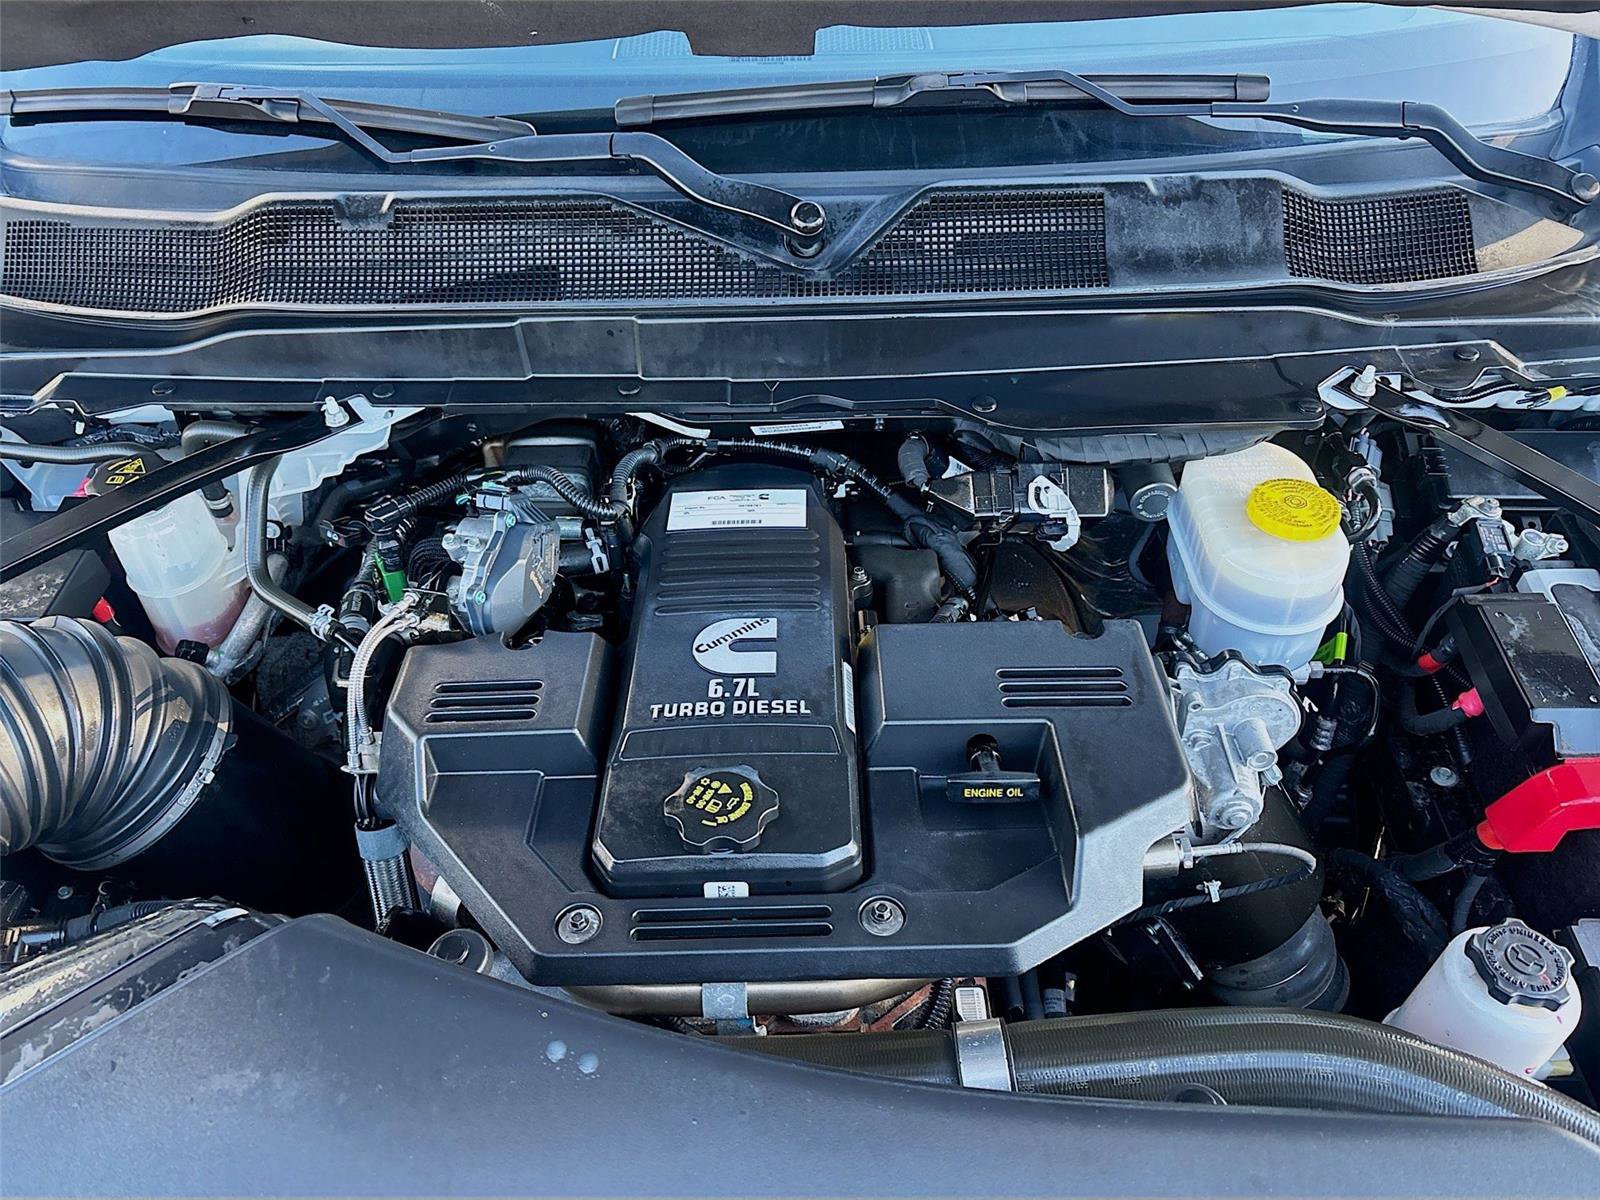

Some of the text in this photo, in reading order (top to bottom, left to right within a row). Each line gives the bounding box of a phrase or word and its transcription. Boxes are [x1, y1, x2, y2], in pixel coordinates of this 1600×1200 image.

[694, 617, 770, 653] Cummins
[707, 677, 760, 699] 6.7L
[650, 699, 812, 719] TURBO DIESEL
[964, 788, 1024, 797] ENGINE OIL
